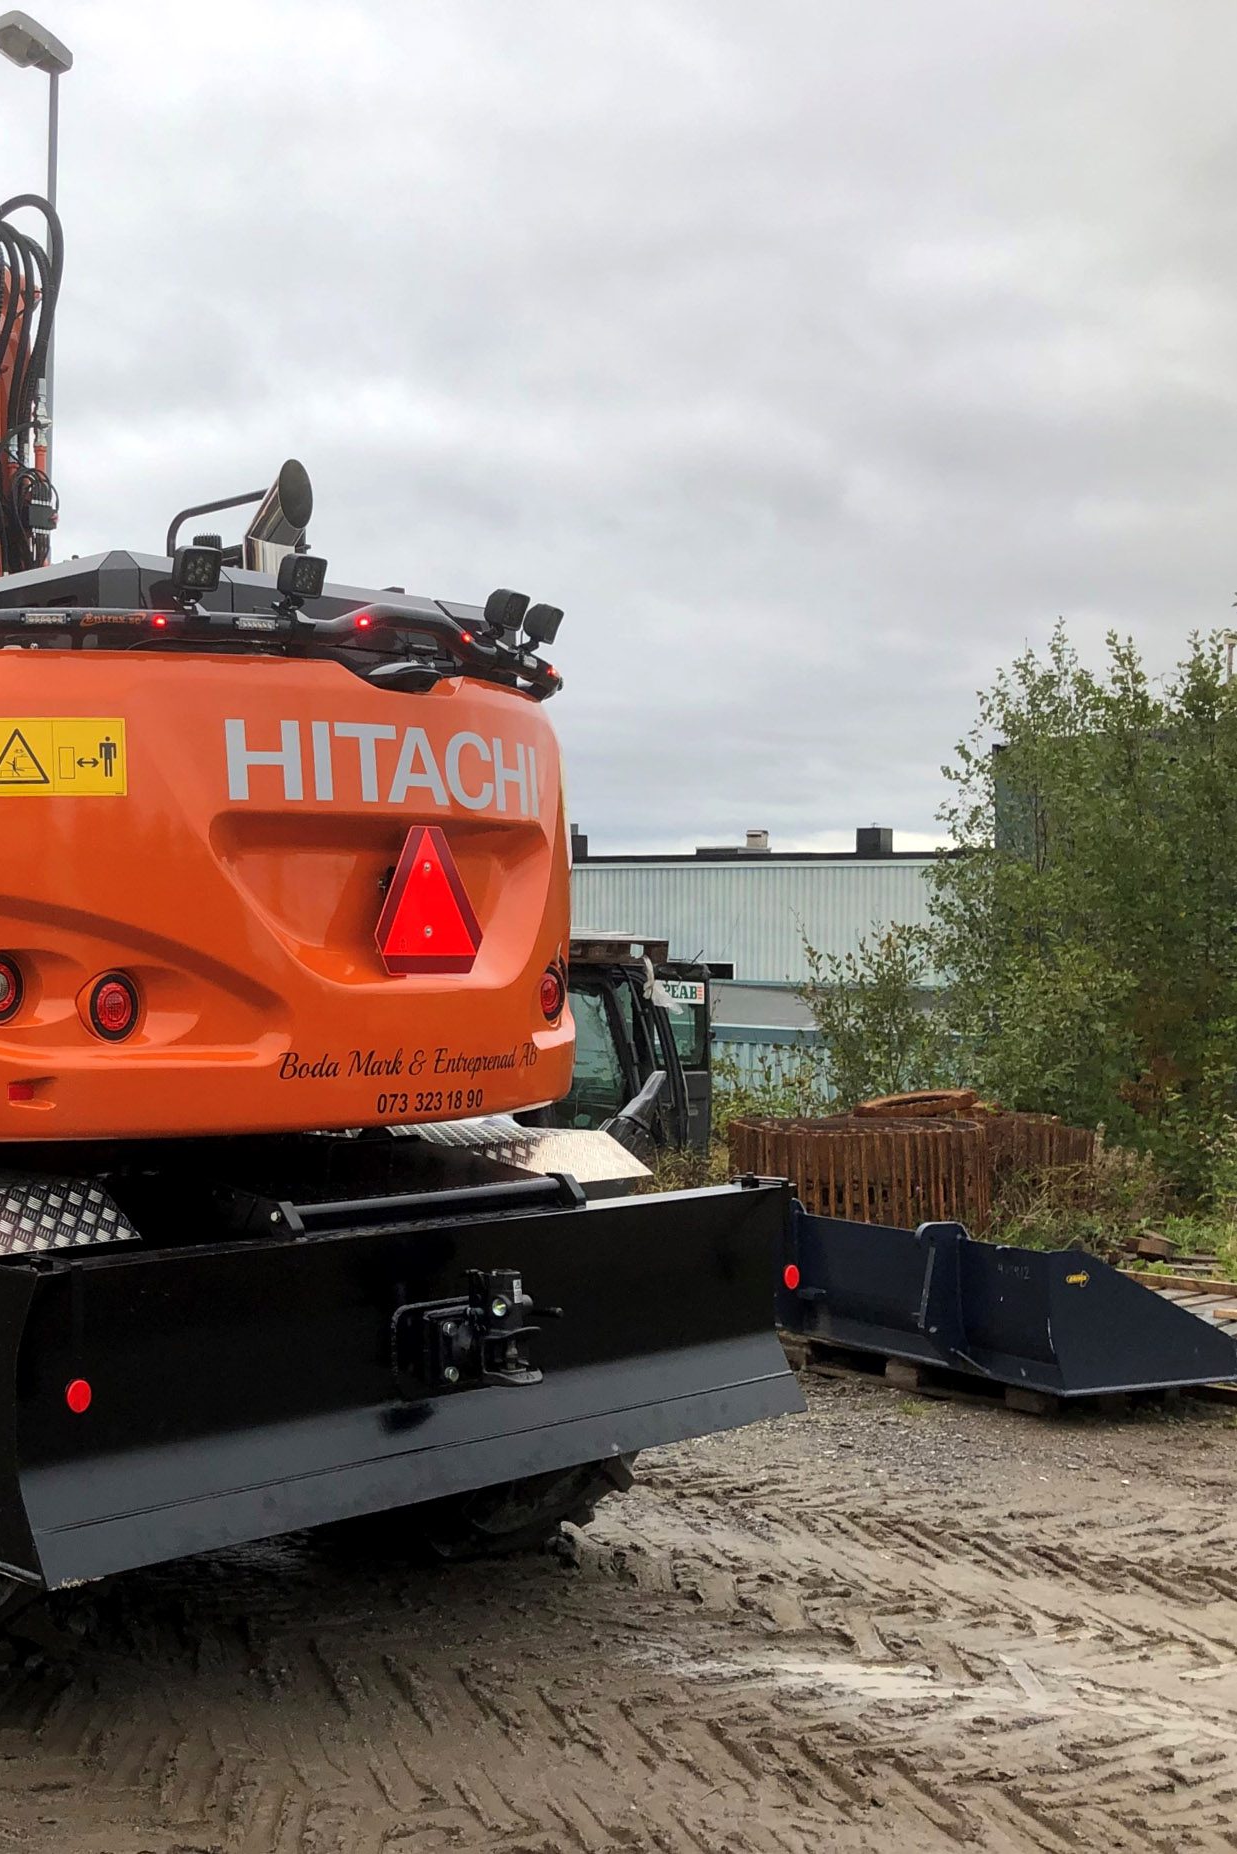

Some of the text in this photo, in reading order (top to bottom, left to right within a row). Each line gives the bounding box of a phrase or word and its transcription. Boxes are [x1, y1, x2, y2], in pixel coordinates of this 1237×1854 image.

[225, 719, 540, 817] HITACHI
[279, 1052, 340, 1079] Boda
[348, 1049, 403, 1078] Mark
[409, 1049, 427, 1075] &
[434, 1047, 516, 1080] Entreprenad
[377, 1089, 483, 1113] 073 323 18 90
